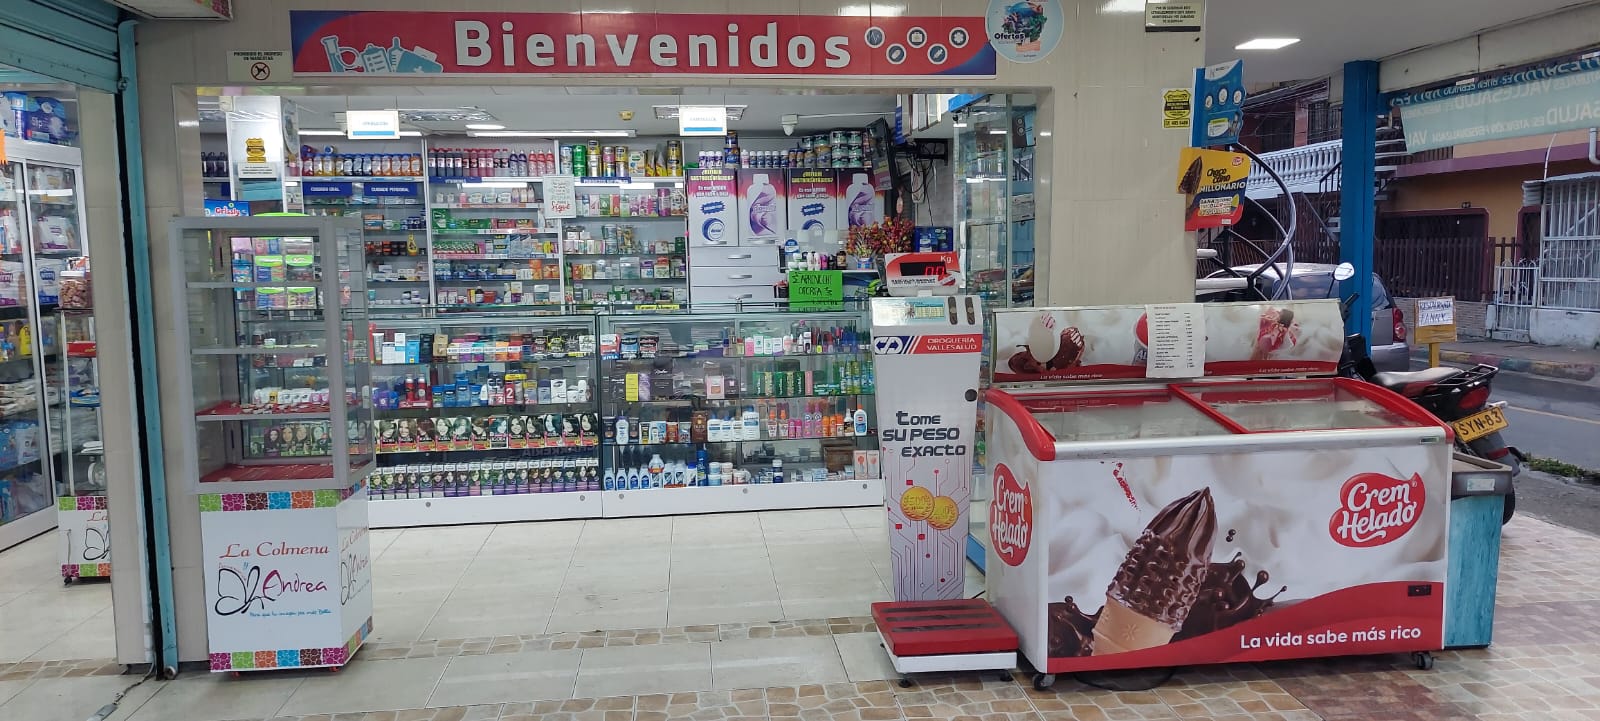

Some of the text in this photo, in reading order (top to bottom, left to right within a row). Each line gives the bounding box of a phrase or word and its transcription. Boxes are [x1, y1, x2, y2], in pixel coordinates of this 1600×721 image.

[455, 20, 851, 68] Bienvenidos
[994, 32, 1025, 40] Ofertas
[1200, 181, 1246, 193] MILLONARIO
[882, 427, 960, 442] SU PESO
[996, 474, 1026, 522] Crem
[1347, 482, 1409, 512] Crem
[992, 504, 1028, 557] Helado
[1337, 501, 1417, 542] Helado
[219, 541, 331, 559] La Colmena
[262, 569, 327, 601] Andrea
[1240, 625, 1421, 649] La vida sabe más rico
